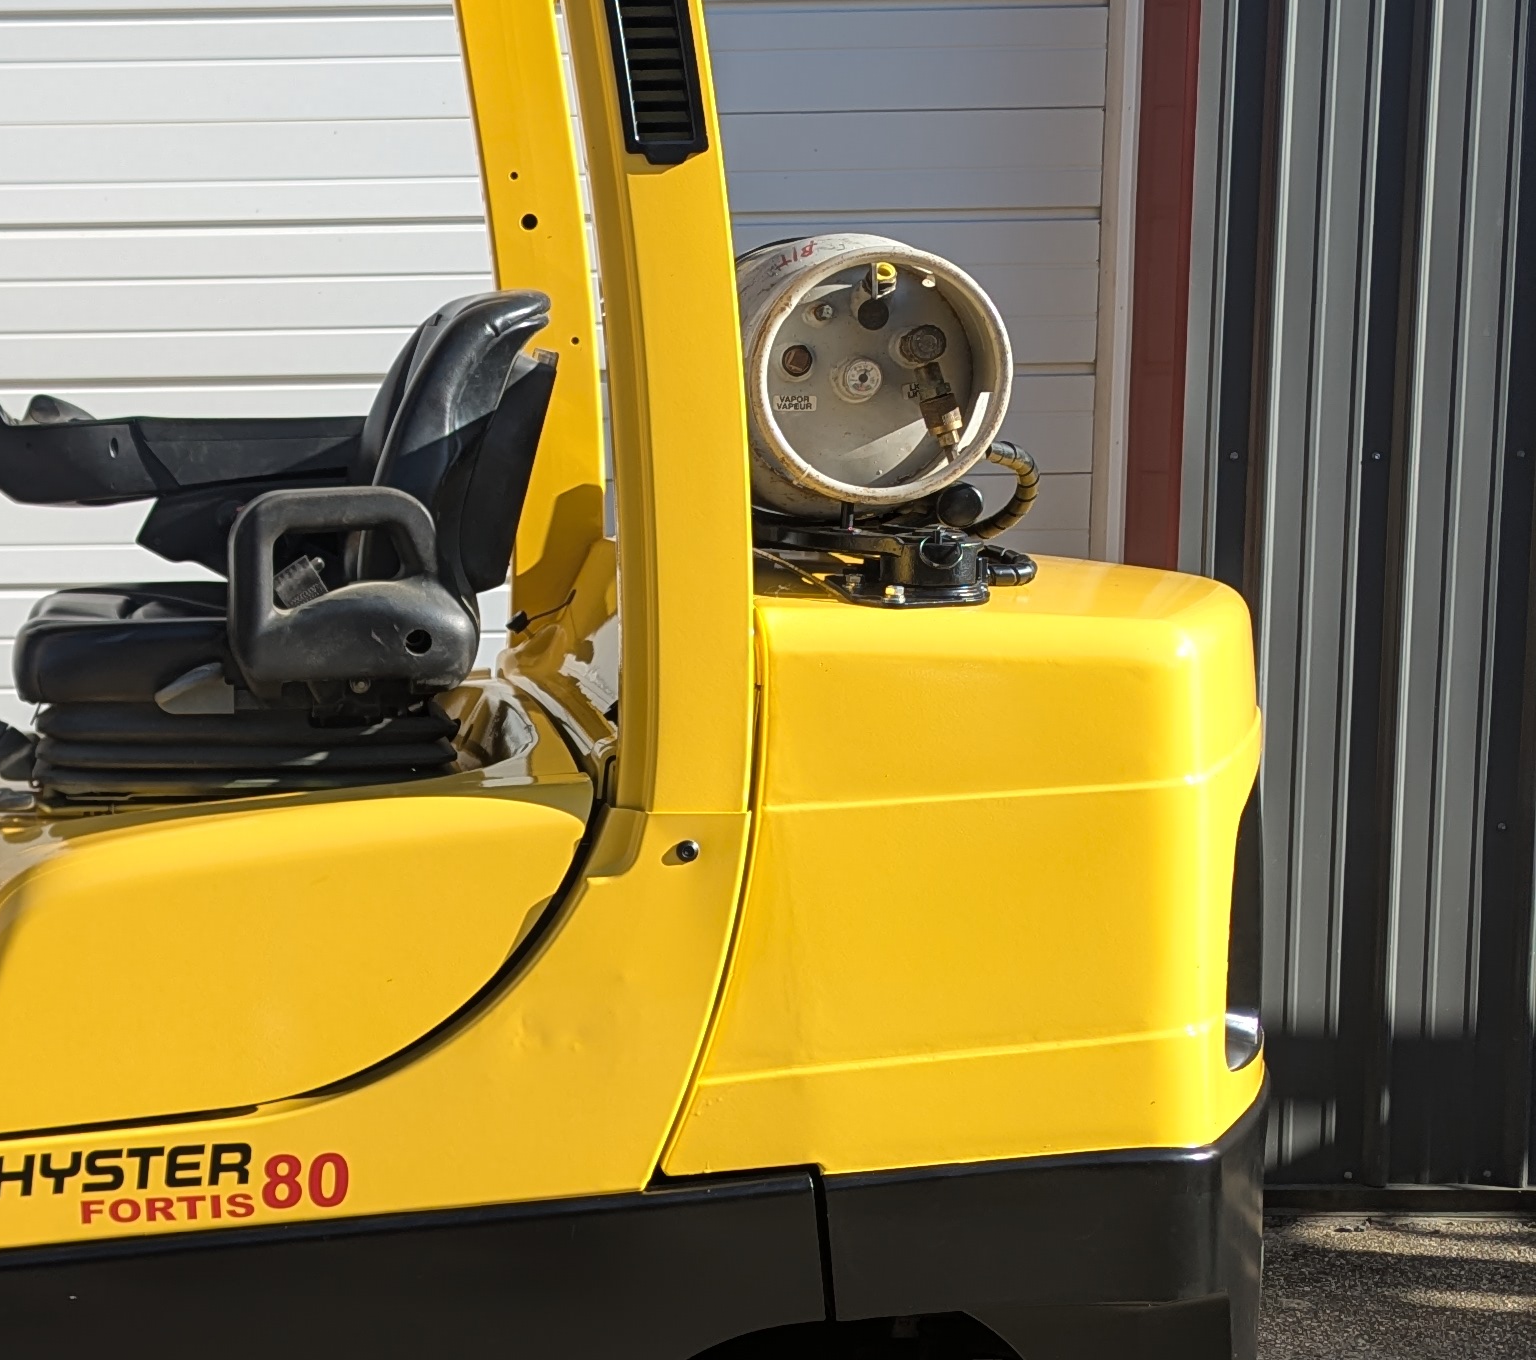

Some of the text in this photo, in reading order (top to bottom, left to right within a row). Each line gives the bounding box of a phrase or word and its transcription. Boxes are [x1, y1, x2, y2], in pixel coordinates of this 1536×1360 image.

[779, 395, 810, 403] VAPOR
[776, 402, 813, 410] VAPEUR
[80, 1152, 350, 1224] FORTIS 80
